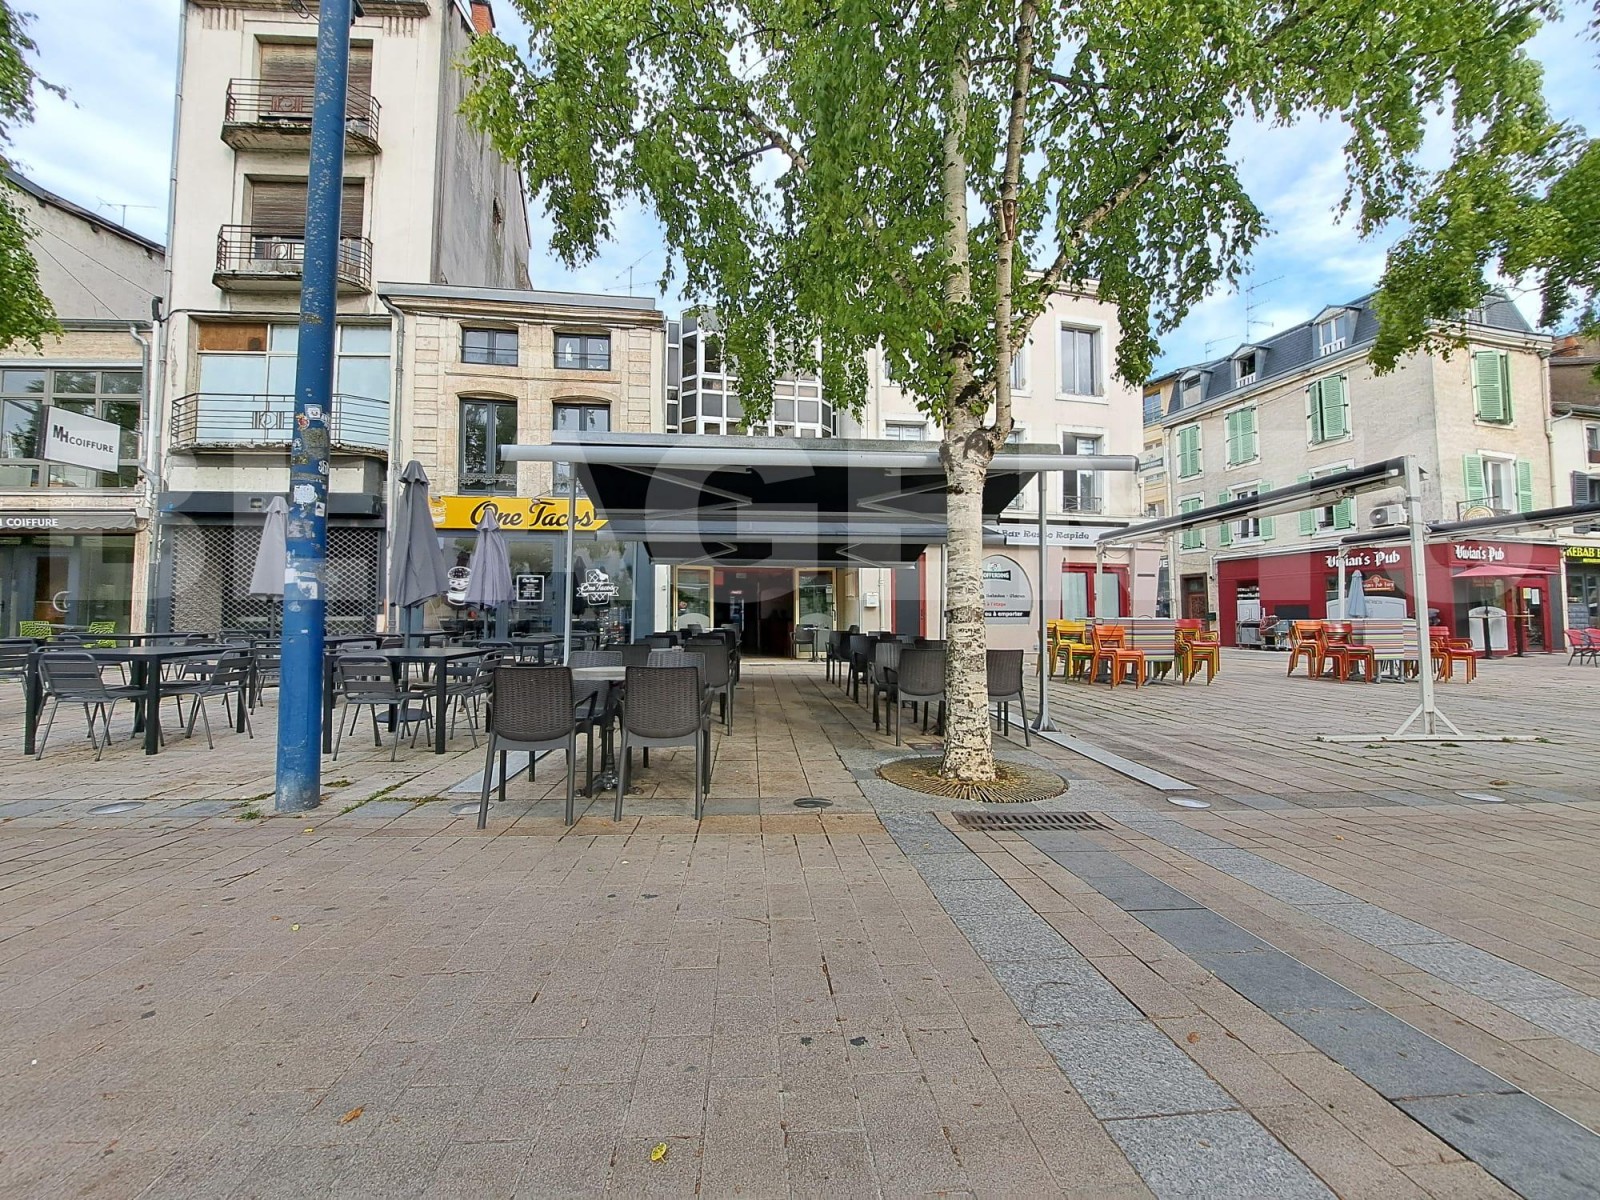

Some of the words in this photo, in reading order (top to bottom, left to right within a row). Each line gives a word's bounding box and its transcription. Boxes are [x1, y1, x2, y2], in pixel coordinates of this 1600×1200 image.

[69, 436, 114, 453] COIFFURE
[6, 517, 59, 527] COIFFURE
[470, 500, 524, 527] One
[1002, 529, 1020, 538] Bar
[1023, 529, 1053, 539] Reso
[1056, 531, 1090, 541] Rapide
[1325, 552, 1371, 568] Viian's
[1373, 549, 1400, 567] Pub
[1455, 544, 1486, 560] Vivian's
[1487, 546, 1505, 562] Pub
[1566, 546, 1595, 557] KEBAB
